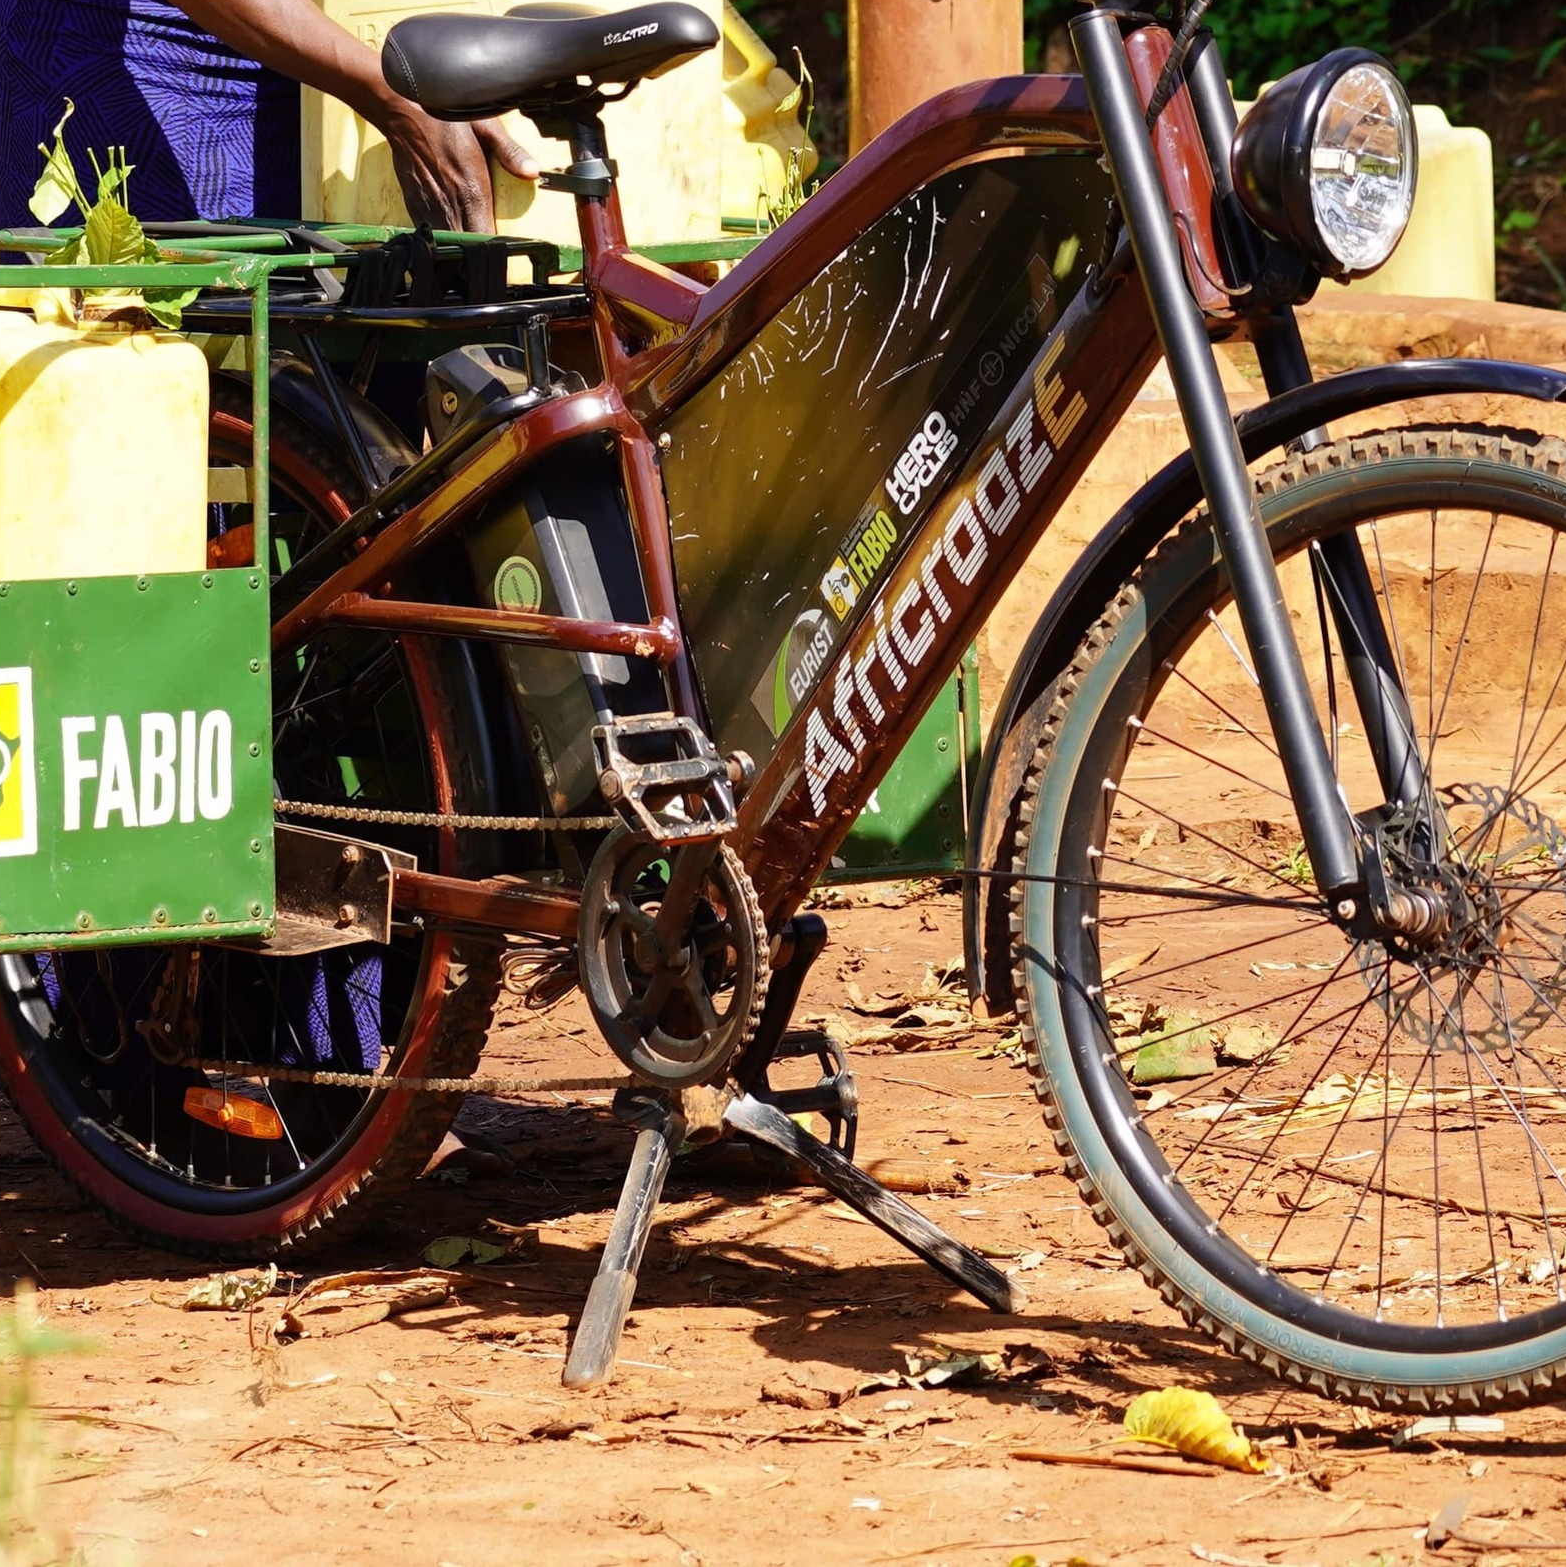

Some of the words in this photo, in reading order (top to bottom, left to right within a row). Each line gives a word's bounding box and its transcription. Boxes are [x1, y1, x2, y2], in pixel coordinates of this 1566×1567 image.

[949, 378, 983, 427] HNF
[999, 273, 1058, 357] NICOLAI
[885, 410, 947, 503] HERO
[898, 428, 959, 515] CYCLES
[848, 510, 897, 588] FABIO
[789, 617, 835, 702] EURIST
[61, 709, 232, 831] FABIO
